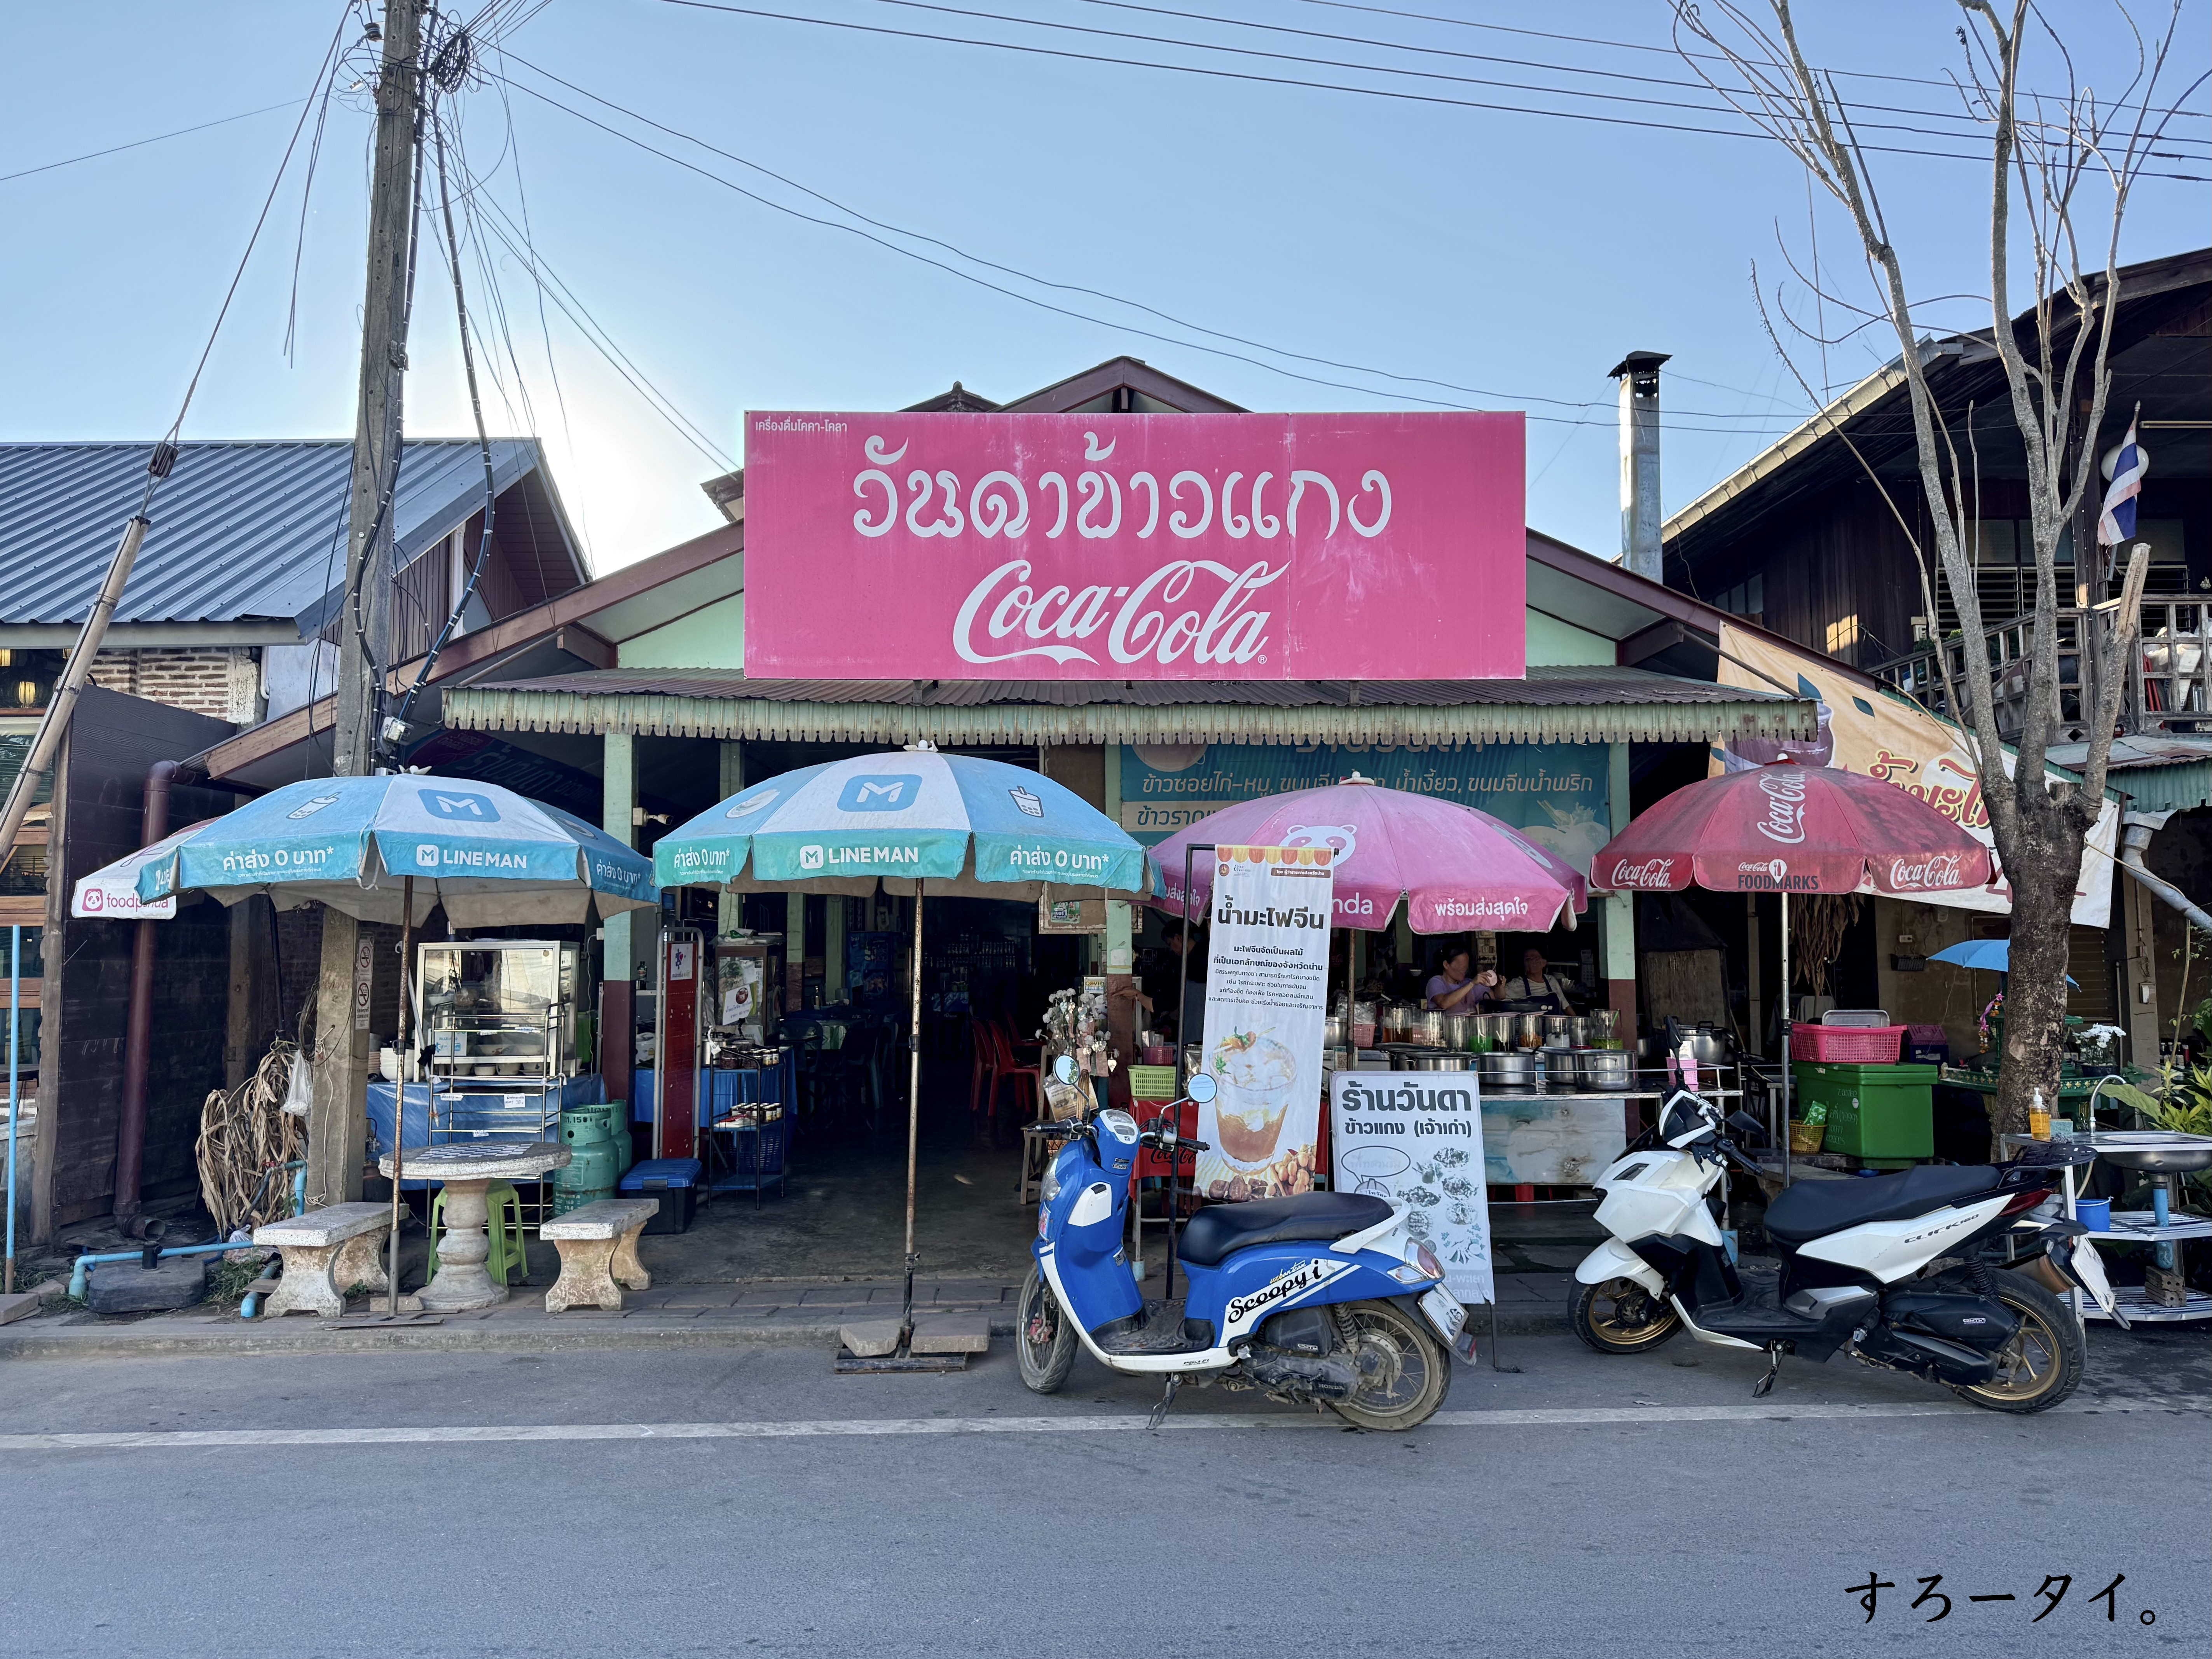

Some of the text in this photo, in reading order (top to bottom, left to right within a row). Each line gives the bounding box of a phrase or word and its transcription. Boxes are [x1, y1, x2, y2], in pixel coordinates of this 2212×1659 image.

[755, 416, 847, 432] เครื่องดื่มโคคา-โคลา
[852, 430, 1392, 540] วันดาข้าวแกง
[952, 559, 1291, 667] Coca-Cola
[1468, 768, 1593, 792] ขนมจีนน้ำพริก
[1757, 770, 1807, 844] Coca-Cola
[223, 849, 269, 871] ค่าส่ง
[674, 846, 700, 868] ค่าส่ง
[1010, 844, 1051, 866] ค่าส่ง
[1738, 861, 1770, 872] Coca-Cola
[596, 859, 616, 879] ค่าส่ง
[1611, 859, 1675, 888] Coca-Cola
[1890, 855, 1962, 890] Coca-Cola
[1738, 874, 1819, 890] FOODMARKS
[1218, 895, 1324, 929] น้ำมะไฟจีน
[1435, 896, 1528, 921] พร้อมส่งสุดใจ
[1234, 945, 1304, 956] มะไฟจีนจัดเป็นผลไม้
[1213, 954, 1323, 971] ที่เป็นเอกลักษณ์ของจังหวัดน่าน
[1342, 1081, 1472, 1111] ร้านวันดา
[1345, 1118, 1472, 1138] ข้าวแกง (เจ้าเก่า)
[1228, 1271, 1308, 1324] Scoopy
